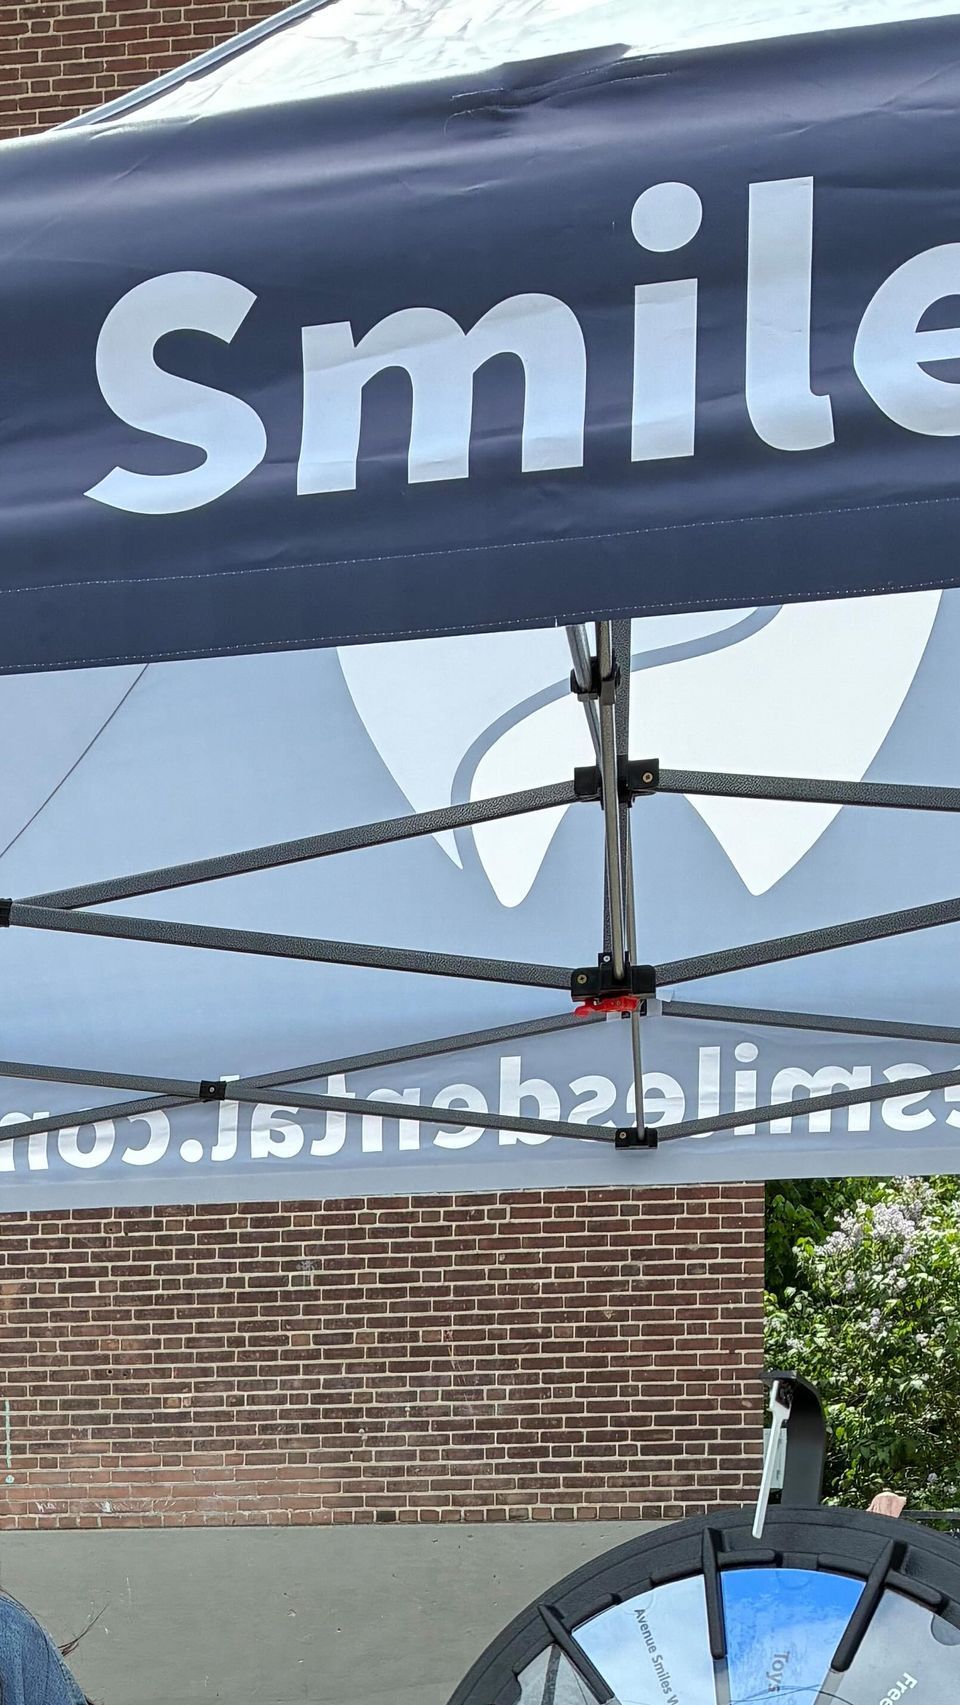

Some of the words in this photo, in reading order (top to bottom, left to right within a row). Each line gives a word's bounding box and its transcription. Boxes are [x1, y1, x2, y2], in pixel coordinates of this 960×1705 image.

[634, 1608, 657, 1653] Avenue
[652, 1655, 672, 1695] Smiles
[766, 1651, 790, 1693] Toys
